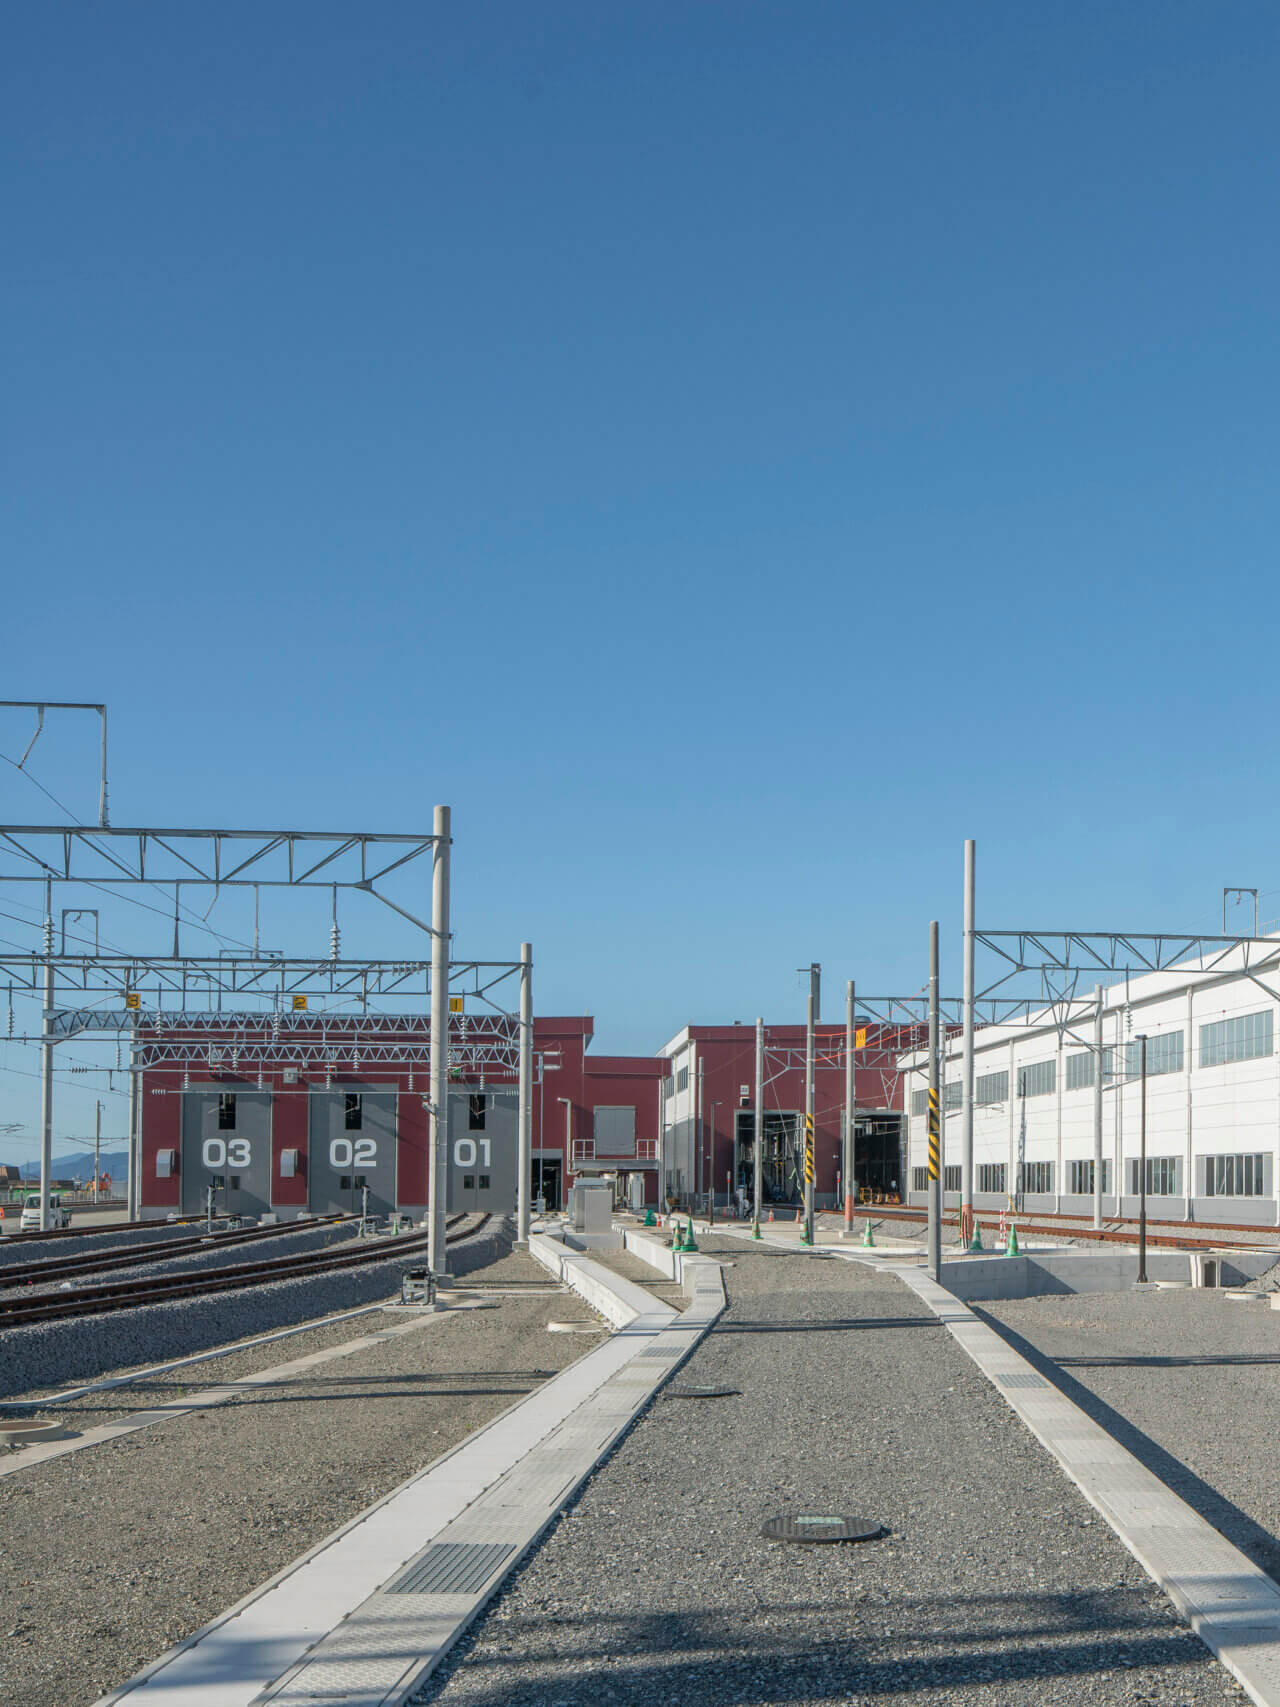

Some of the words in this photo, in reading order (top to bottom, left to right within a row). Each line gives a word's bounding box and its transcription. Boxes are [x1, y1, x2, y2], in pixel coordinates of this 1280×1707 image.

[295, 996, 305, 1009] 2
[202, 1138, 251, 1167] 03
[329, 1138, 377, 1167] 02
[453, 1138, 491, 1167] 01
